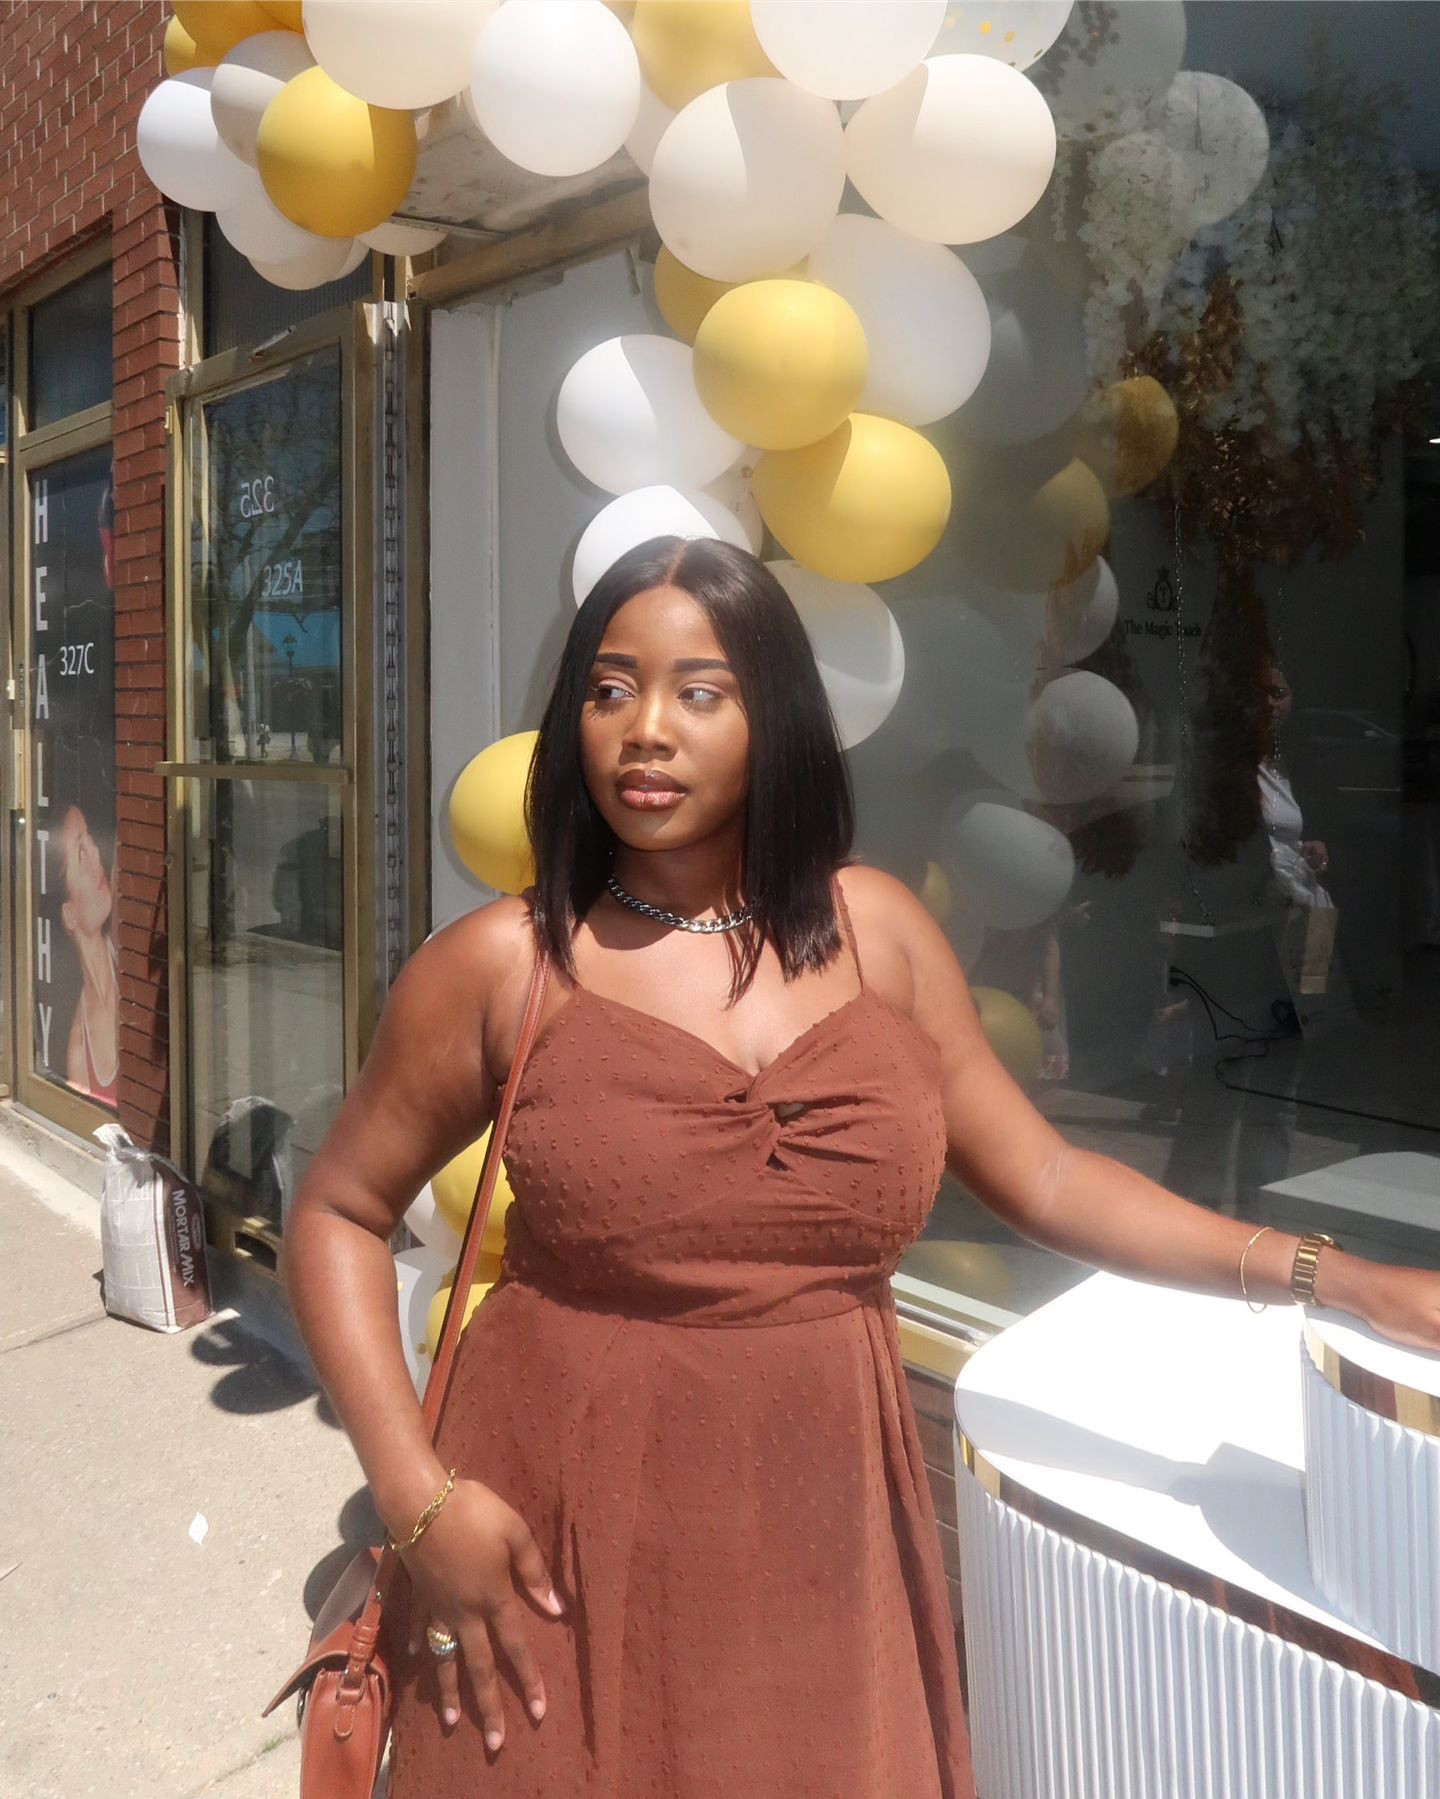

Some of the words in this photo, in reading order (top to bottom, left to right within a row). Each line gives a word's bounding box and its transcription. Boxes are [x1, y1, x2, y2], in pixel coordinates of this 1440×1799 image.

[262, 559, 303, 597] 325A
[1124, 619, 1142, 634] The
[1145, 620, 1173, 639] Magic
[59, 642, 95, 676] 327C
[35, 479, 52, 1067] HEALTHY
[172, 1189, 191, 1253] MORTAR
[180, 1253, 194, 1287] MIX
